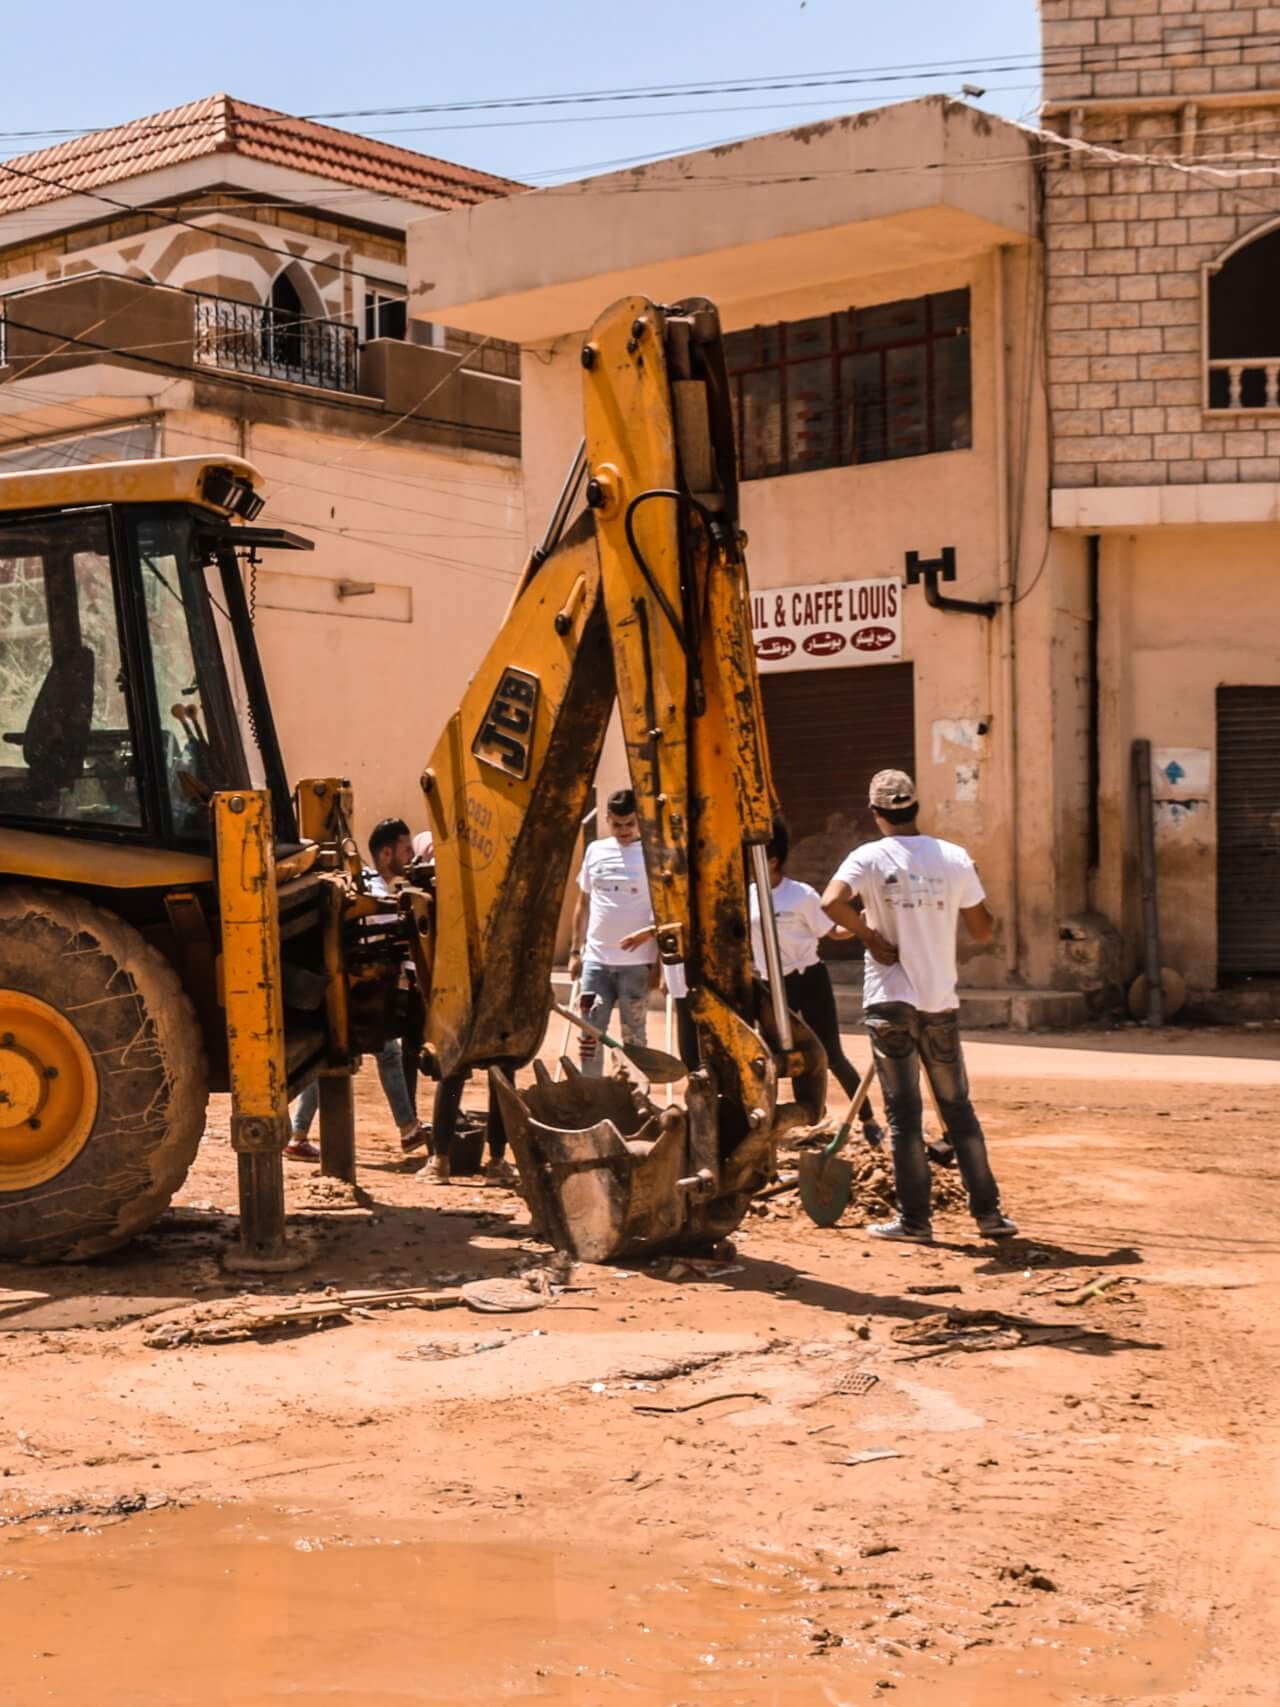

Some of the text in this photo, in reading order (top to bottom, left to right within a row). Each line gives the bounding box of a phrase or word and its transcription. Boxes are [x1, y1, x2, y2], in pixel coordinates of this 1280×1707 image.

[774, 594, 786, 628] &
[792, 590, 843, 626] CAFFE
[849, 584, 897, 621] LOUIS
[480, 675, 536, 771] JCB
